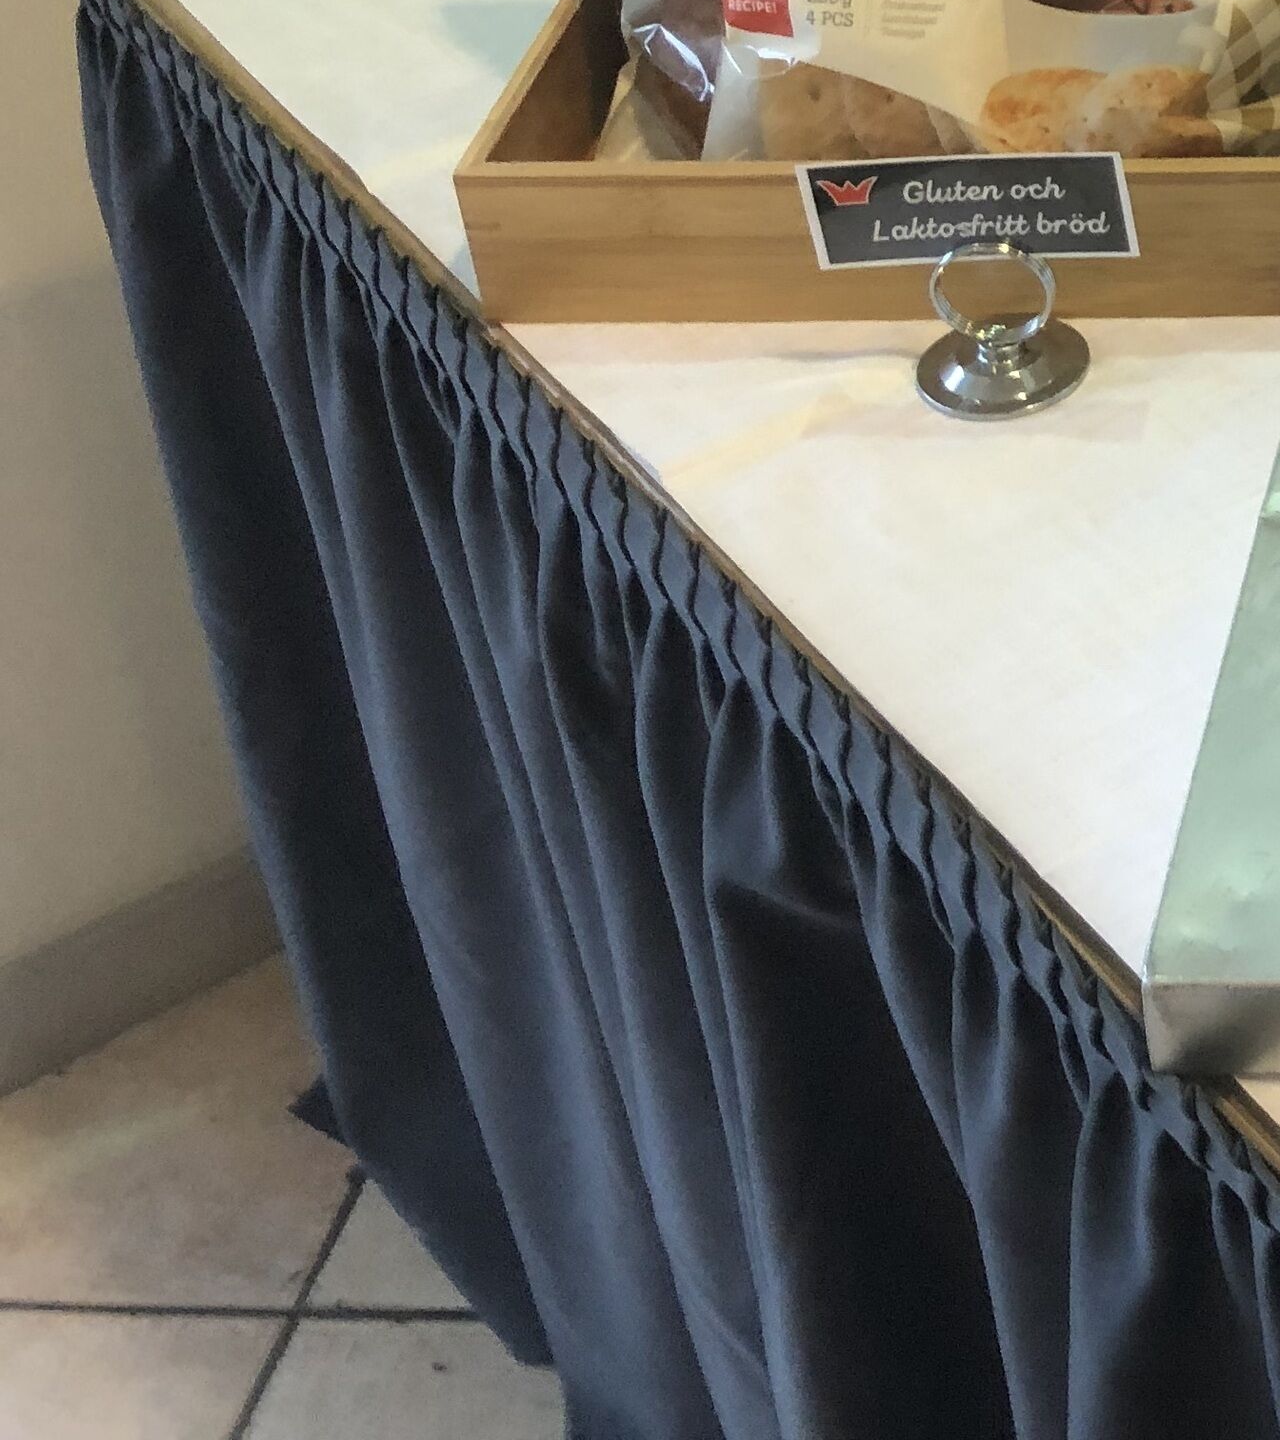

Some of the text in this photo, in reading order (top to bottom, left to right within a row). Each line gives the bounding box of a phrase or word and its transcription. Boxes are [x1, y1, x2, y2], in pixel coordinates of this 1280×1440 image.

[806, 10, 854, 28] 4 PCS
[903, 176, 1066, 203] Gluten och
[872, 211, 1110, 243] Laktosfritt bröd
